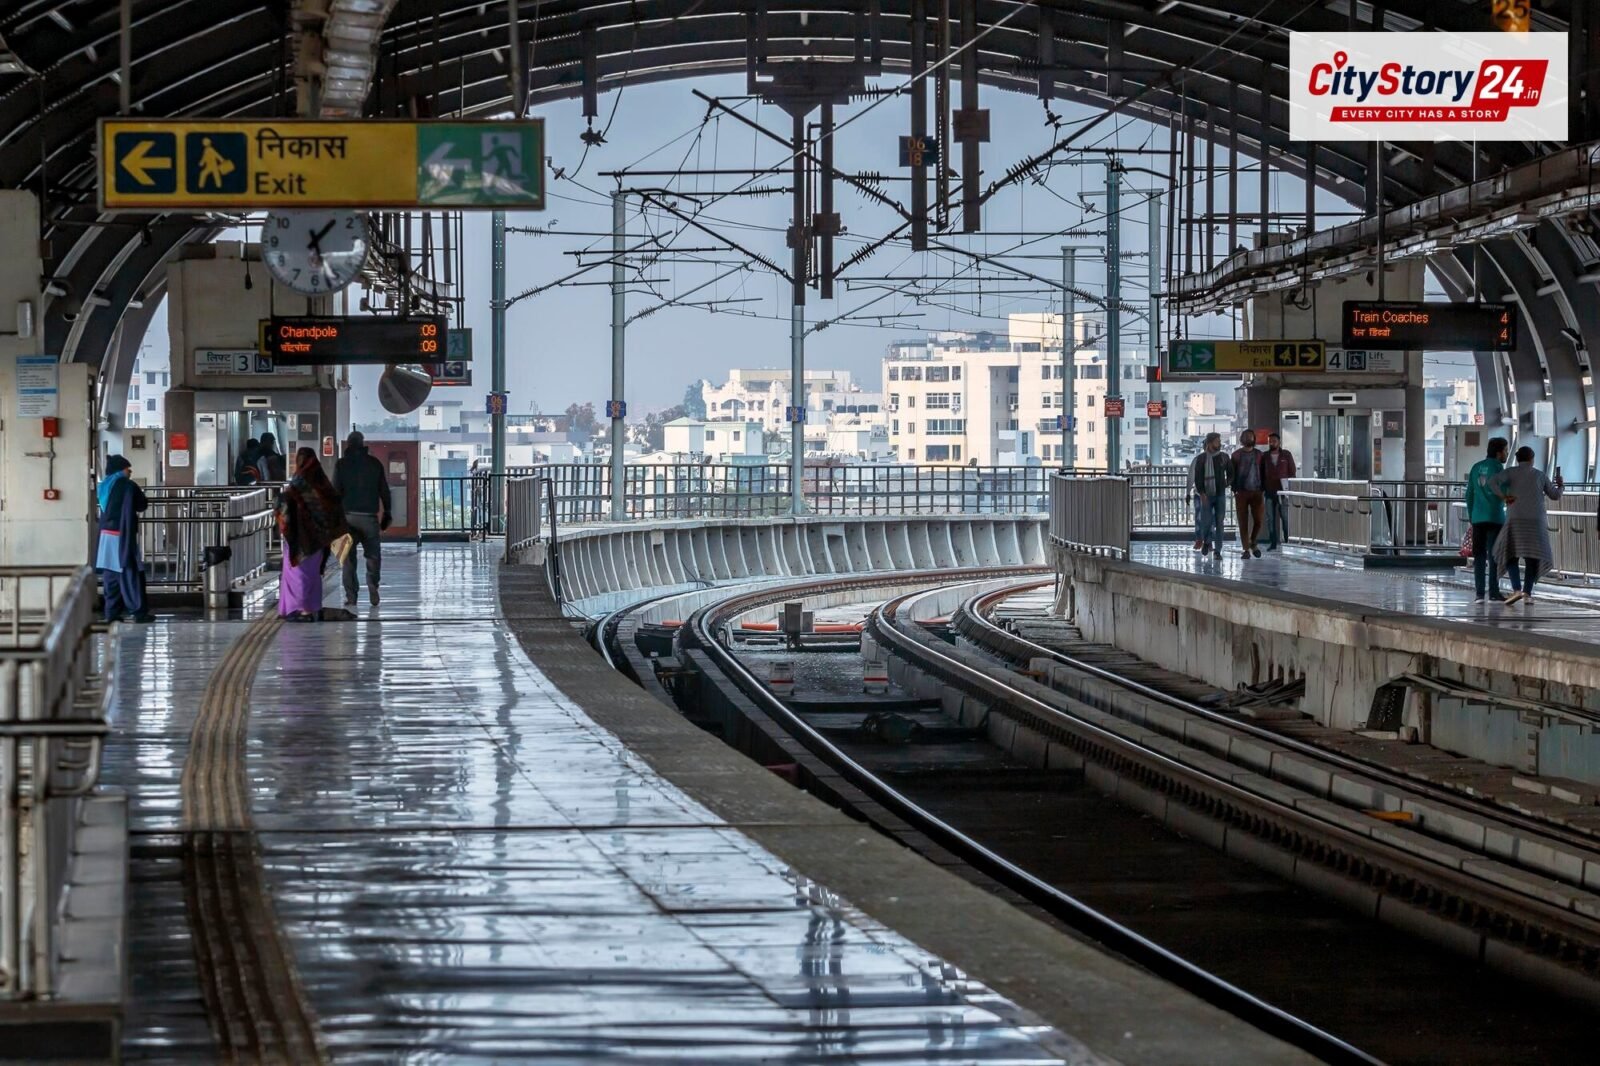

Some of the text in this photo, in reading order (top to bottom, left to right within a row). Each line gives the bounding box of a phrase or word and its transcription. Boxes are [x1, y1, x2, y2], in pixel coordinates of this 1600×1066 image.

[255, 128, 348, 159] निकास
[908, 137, 925, 149] 06
[909, 152, 922, 166] 18
[255, 172, 306, 194] Exit
[277, 217, 290, 229] 10
[346, 218, 354, 229] 2
[270, 236, 279, 248] 9
[293, 269, 301, 280] 7
[311, 275, 319, 286] 6
[1353, 311, 1508, 324] Train Coaches 4
[280, 326, 337, 339] Chandpole
[1501, 328, 1508, 339] 4
[1239, 343, 1272, 354] निकास
[238, 355, 249, 371] 3
[1253, 359, 1272, 367] Exit
[1328, 352, 1384, 369] 4 Lift
